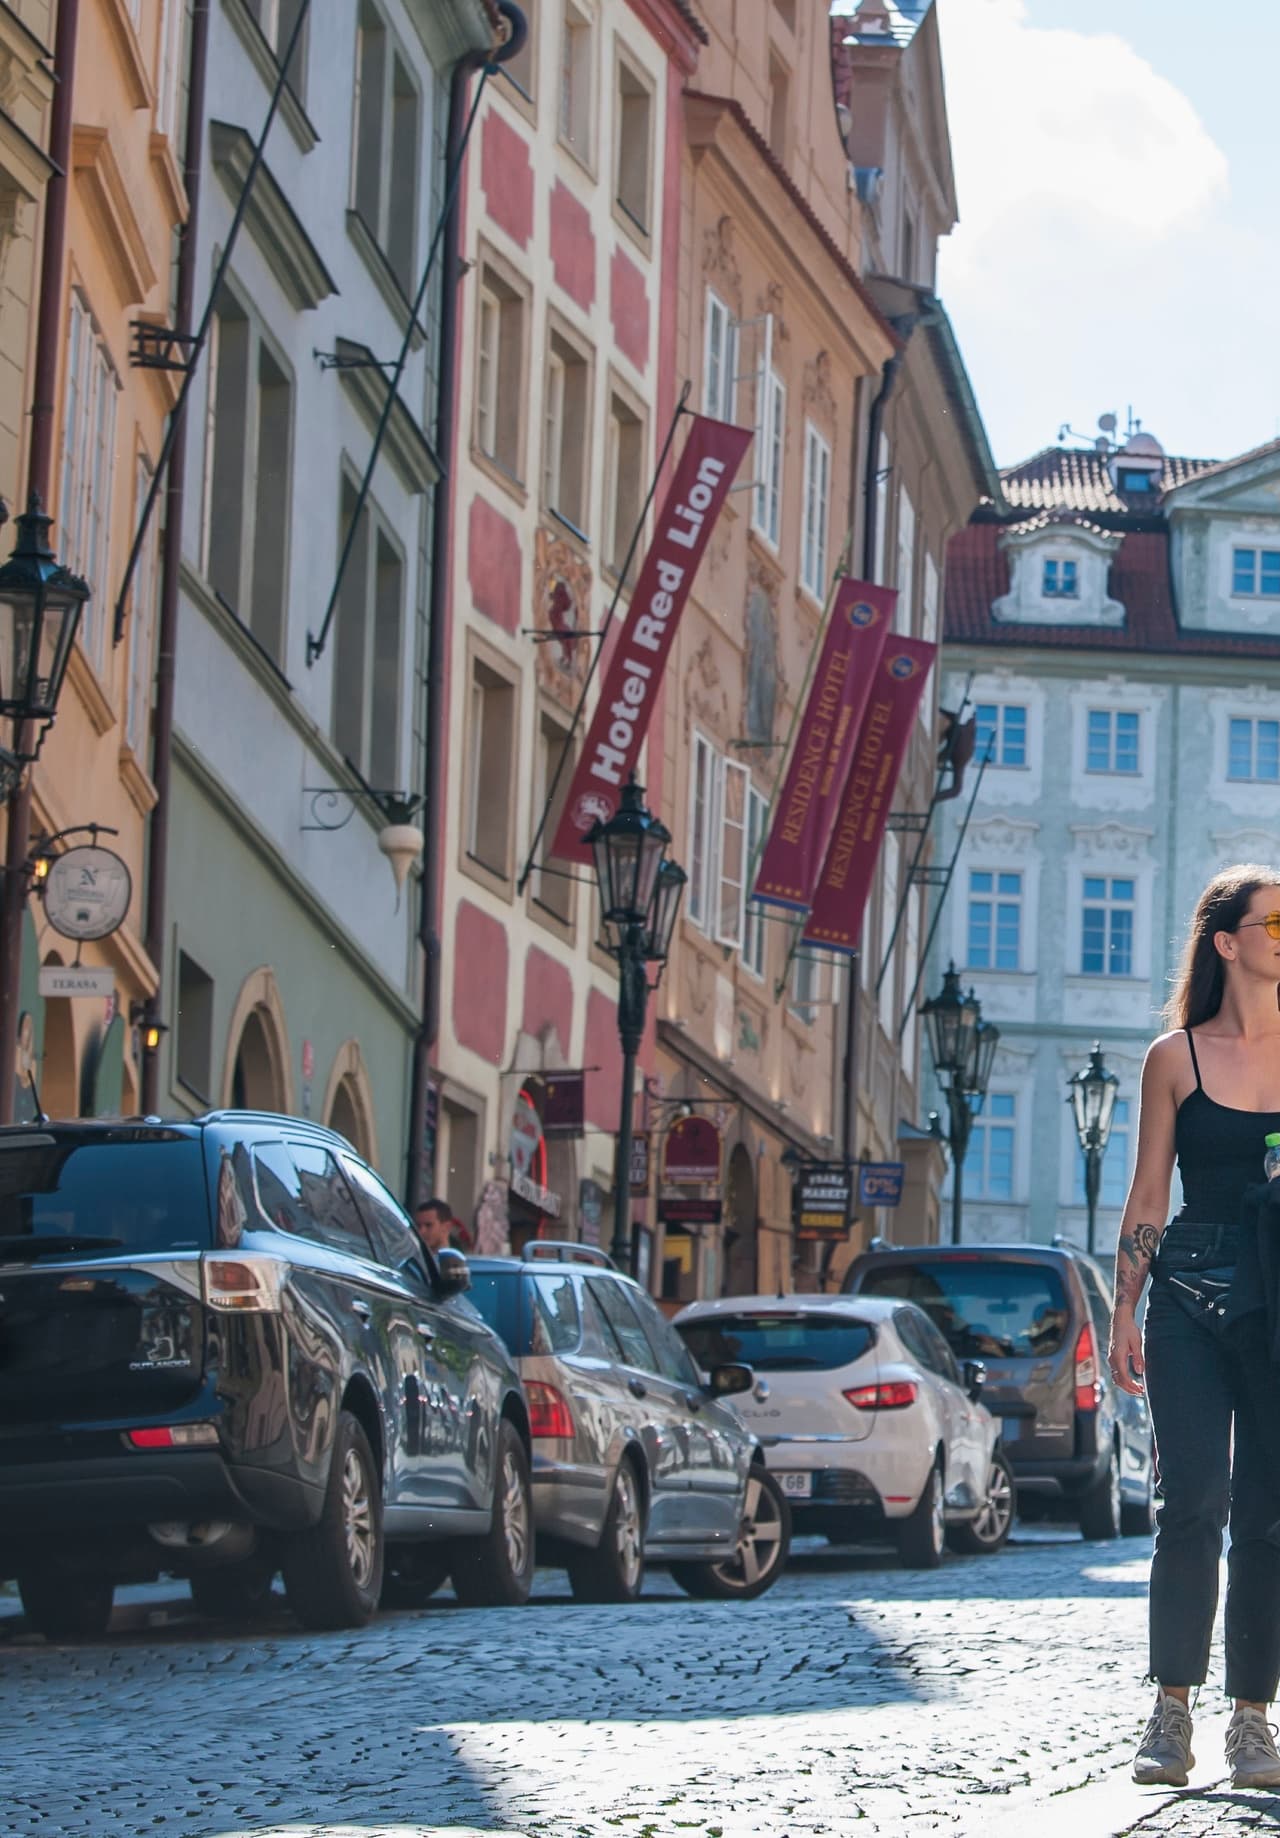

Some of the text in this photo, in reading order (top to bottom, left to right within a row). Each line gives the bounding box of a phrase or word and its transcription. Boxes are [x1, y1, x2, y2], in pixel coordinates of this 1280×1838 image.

[590, 456, 726, 786] Hotel Red Lion
[781, 724, 830, 845] RESIDENCE
[816, 650, 851, 722] HOTEL
[827, 771, 872, 889] RESIDENCE
[861, 700, 894, 769] HOTEL
[802, 1187, 849, 1200] MARKET
[743, 1409, 781, 1418] CLIO
